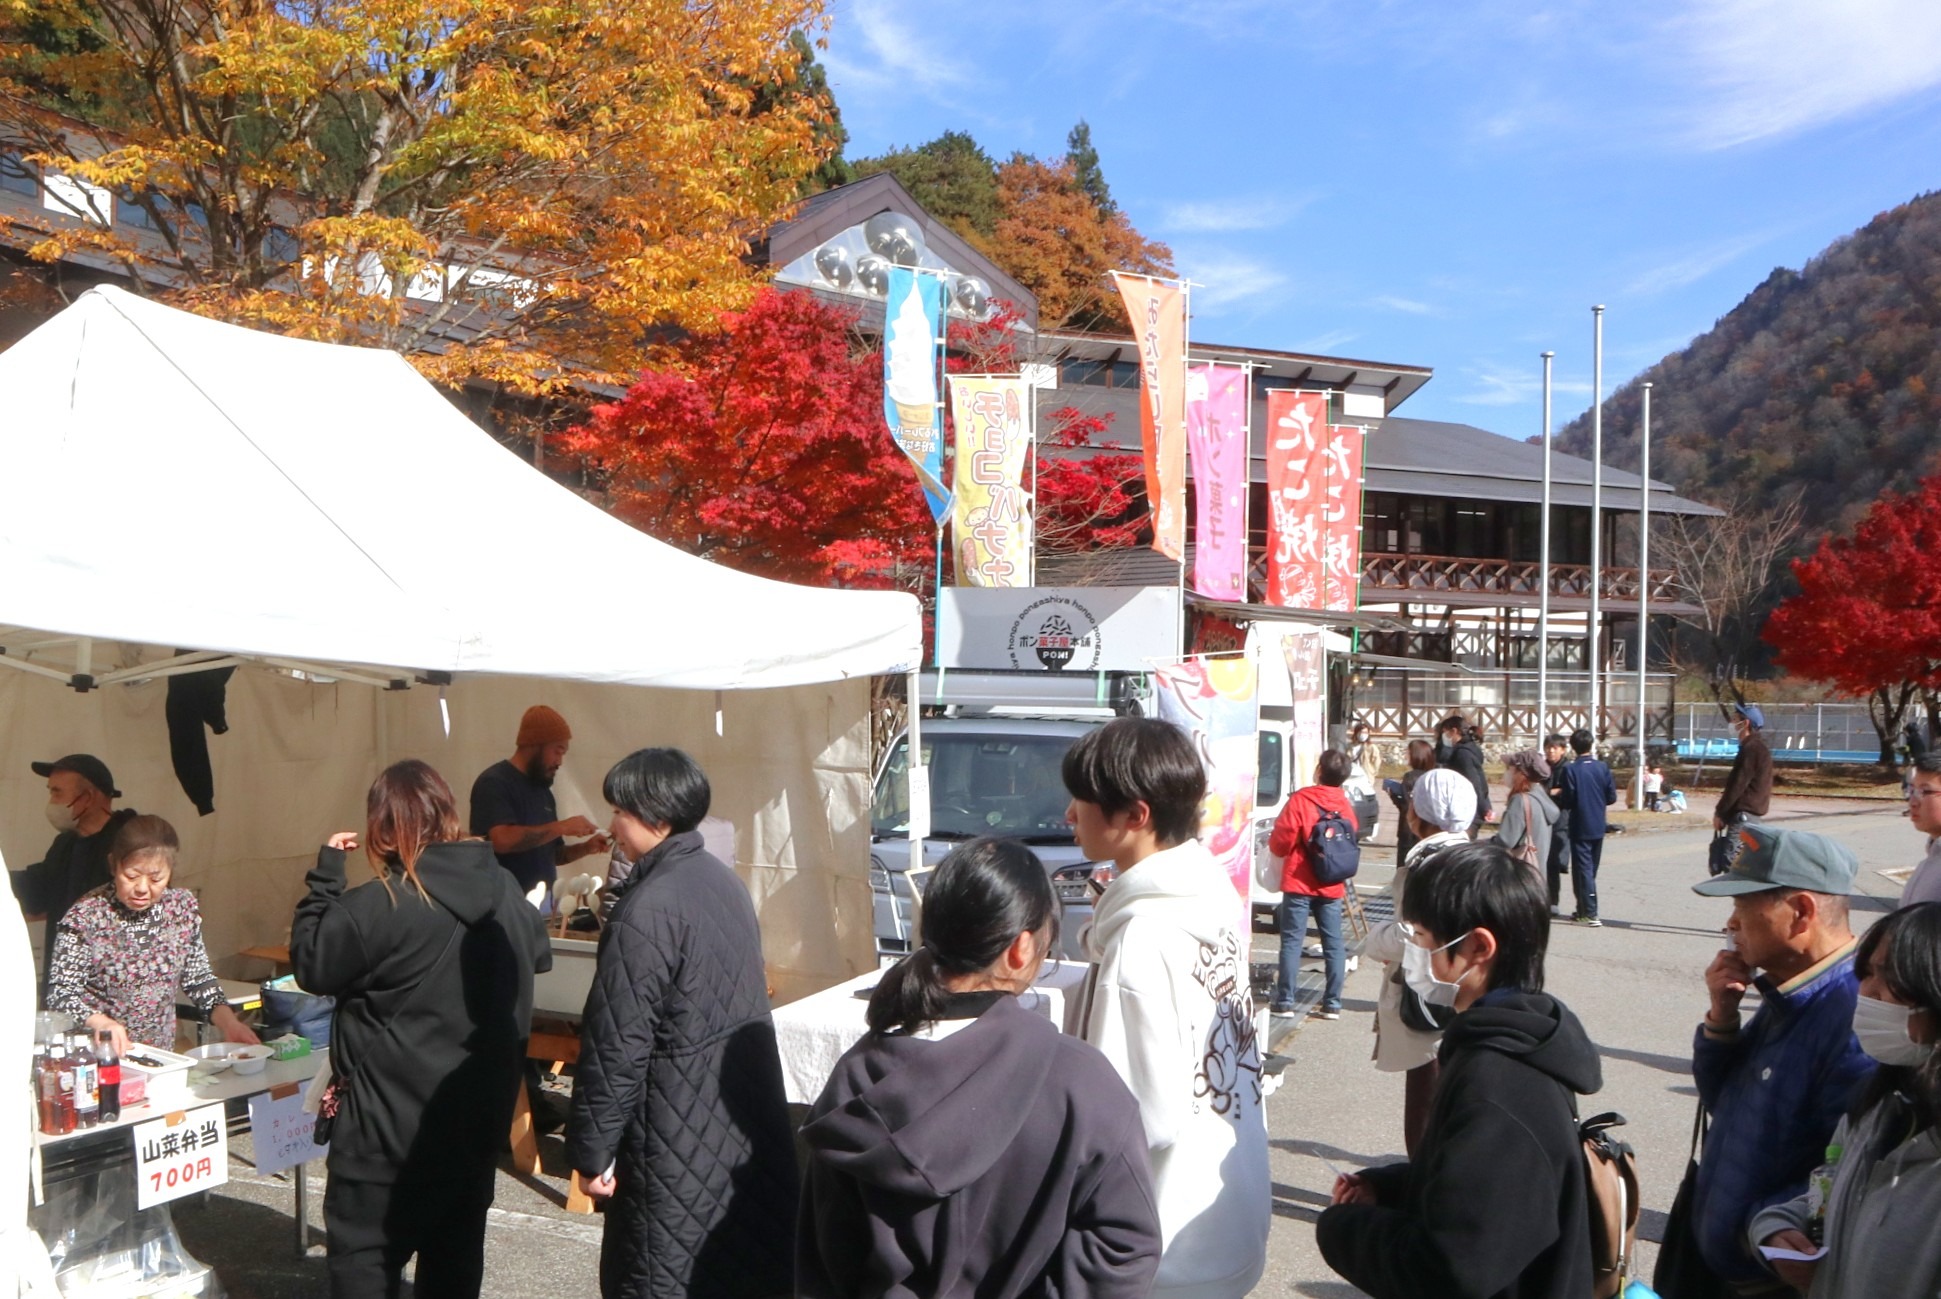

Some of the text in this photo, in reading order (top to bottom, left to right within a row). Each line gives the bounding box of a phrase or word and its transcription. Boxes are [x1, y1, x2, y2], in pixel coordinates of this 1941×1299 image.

[1072, 599, 1096, 625] honpo
[1042, 651, 1069, 659] PON!
[142, 1120, 219, 1164] 山菜弁当
[150, 1157, 212, 1193] 700円
